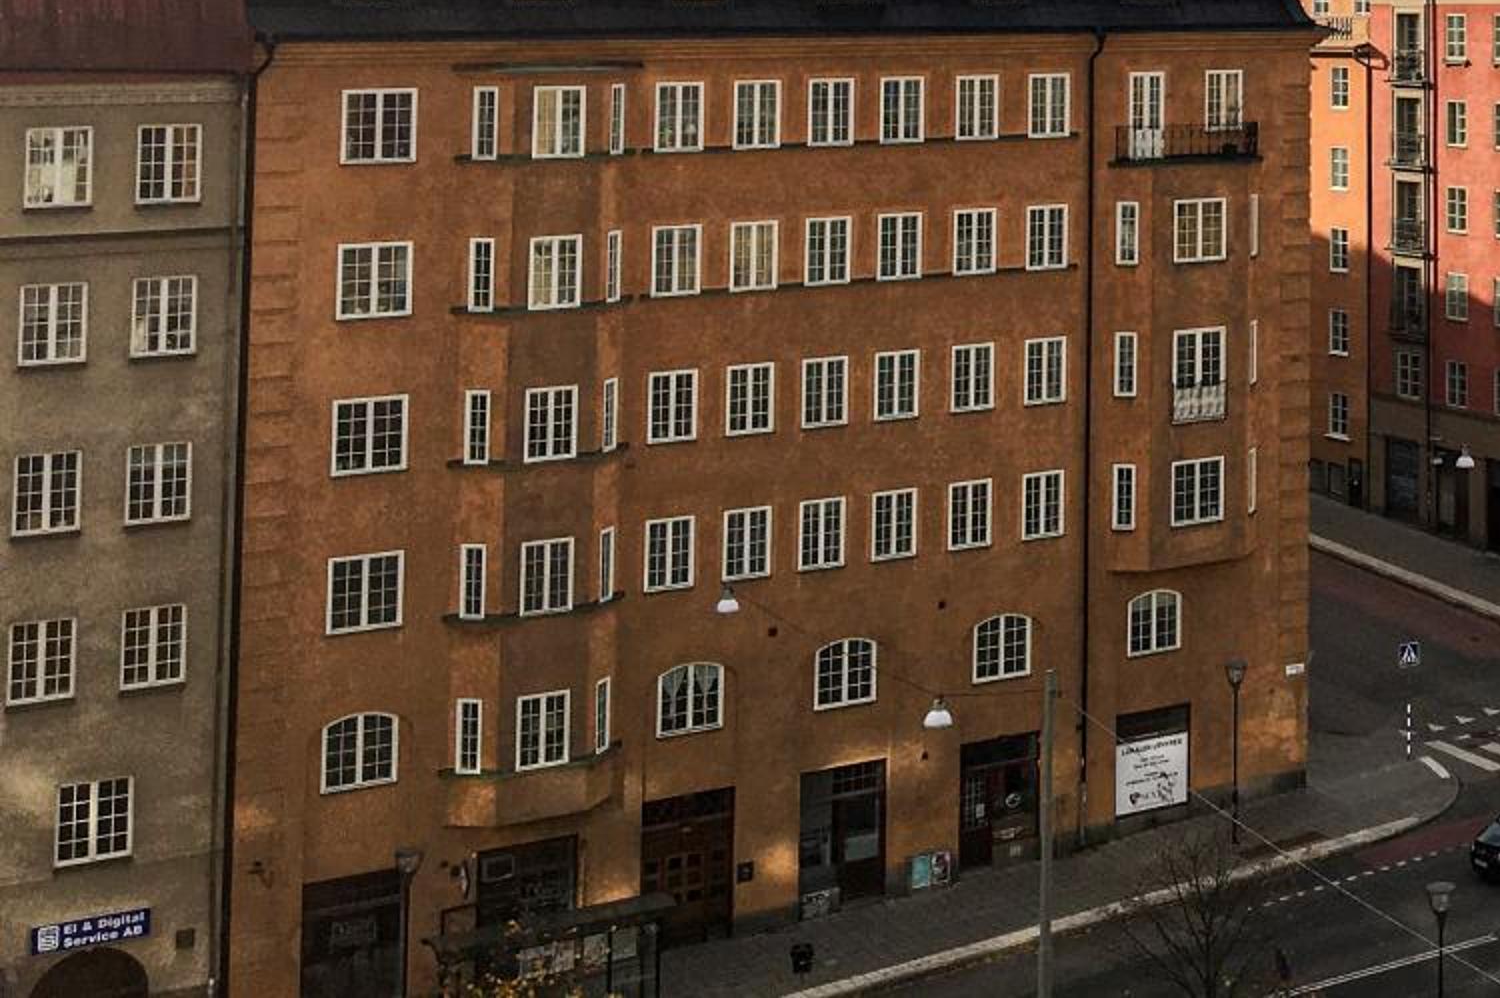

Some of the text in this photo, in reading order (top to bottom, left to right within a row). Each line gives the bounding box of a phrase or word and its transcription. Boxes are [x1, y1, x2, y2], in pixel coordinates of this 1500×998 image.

[63, 911, 145, 935] El & Digital
[63, 924, 143, 948] Service AB
